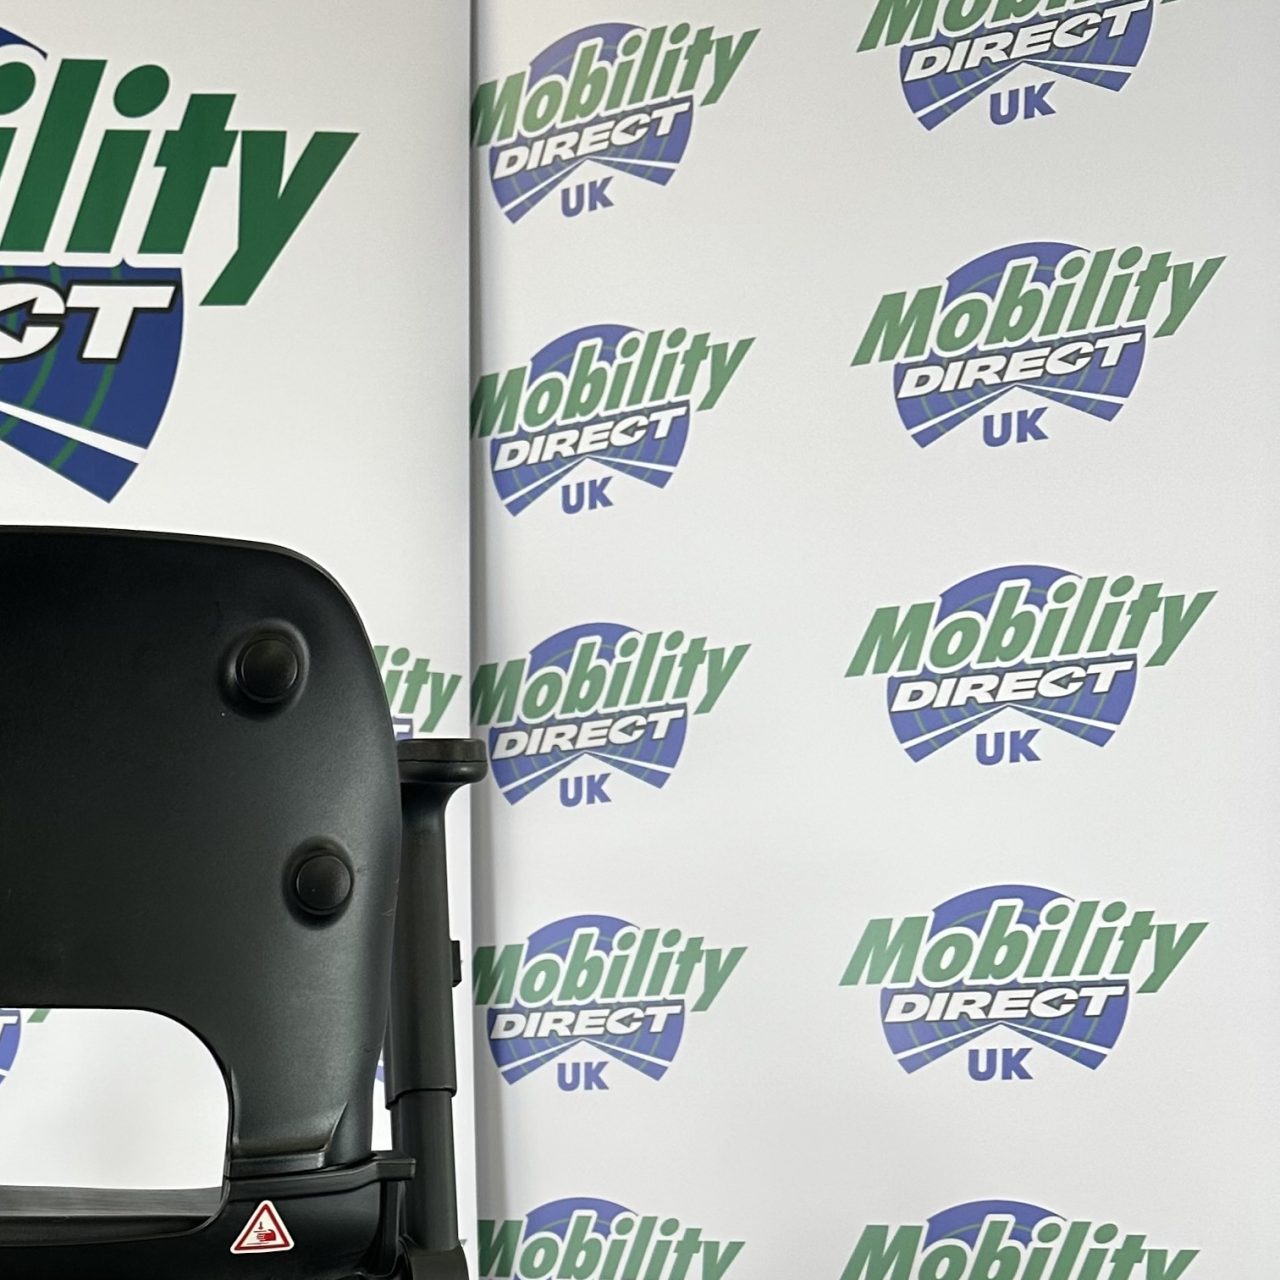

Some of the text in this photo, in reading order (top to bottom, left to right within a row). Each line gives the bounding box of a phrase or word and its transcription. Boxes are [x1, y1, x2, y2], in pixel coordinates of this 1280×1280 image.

[903, 0, 1149, 82] DIRECT
[470, 22, 761, 147] Mobility
[989, 81, 1056, 125] UK
[493, 102, 690, 179] DIRECT
[561, 176, 614, 217] UK
[850, 246, 1227, 367] Mobility
[470, 327, 756, 440] Mobility
[897, 333, 1143, 399] DIRECT
[494, 406, 687, 472] DIRECT
[982, 407, 1049, 447] UK
[561, 476, 613, 514] UK
[844, 575, 1219, 678] Mobility
[470, 630, 752, 726] Mobility
[890, 661, 1134, 712] DIRECT
[492, 709, 684, 760] DIRECT
[975, 729, 1041, 766] UK
[560, 773, 612, 807] UK
[472, 928, 748, 1012] Mobility
[838, 900, 1210, 994] Mobility
[490, 1005, 682, 1039] DIRECT
[884, 986, 1125, 1023] DIRECT
[557, 1061, 609, 1092] UK
[968, 1048, 1033, 1081] UK
